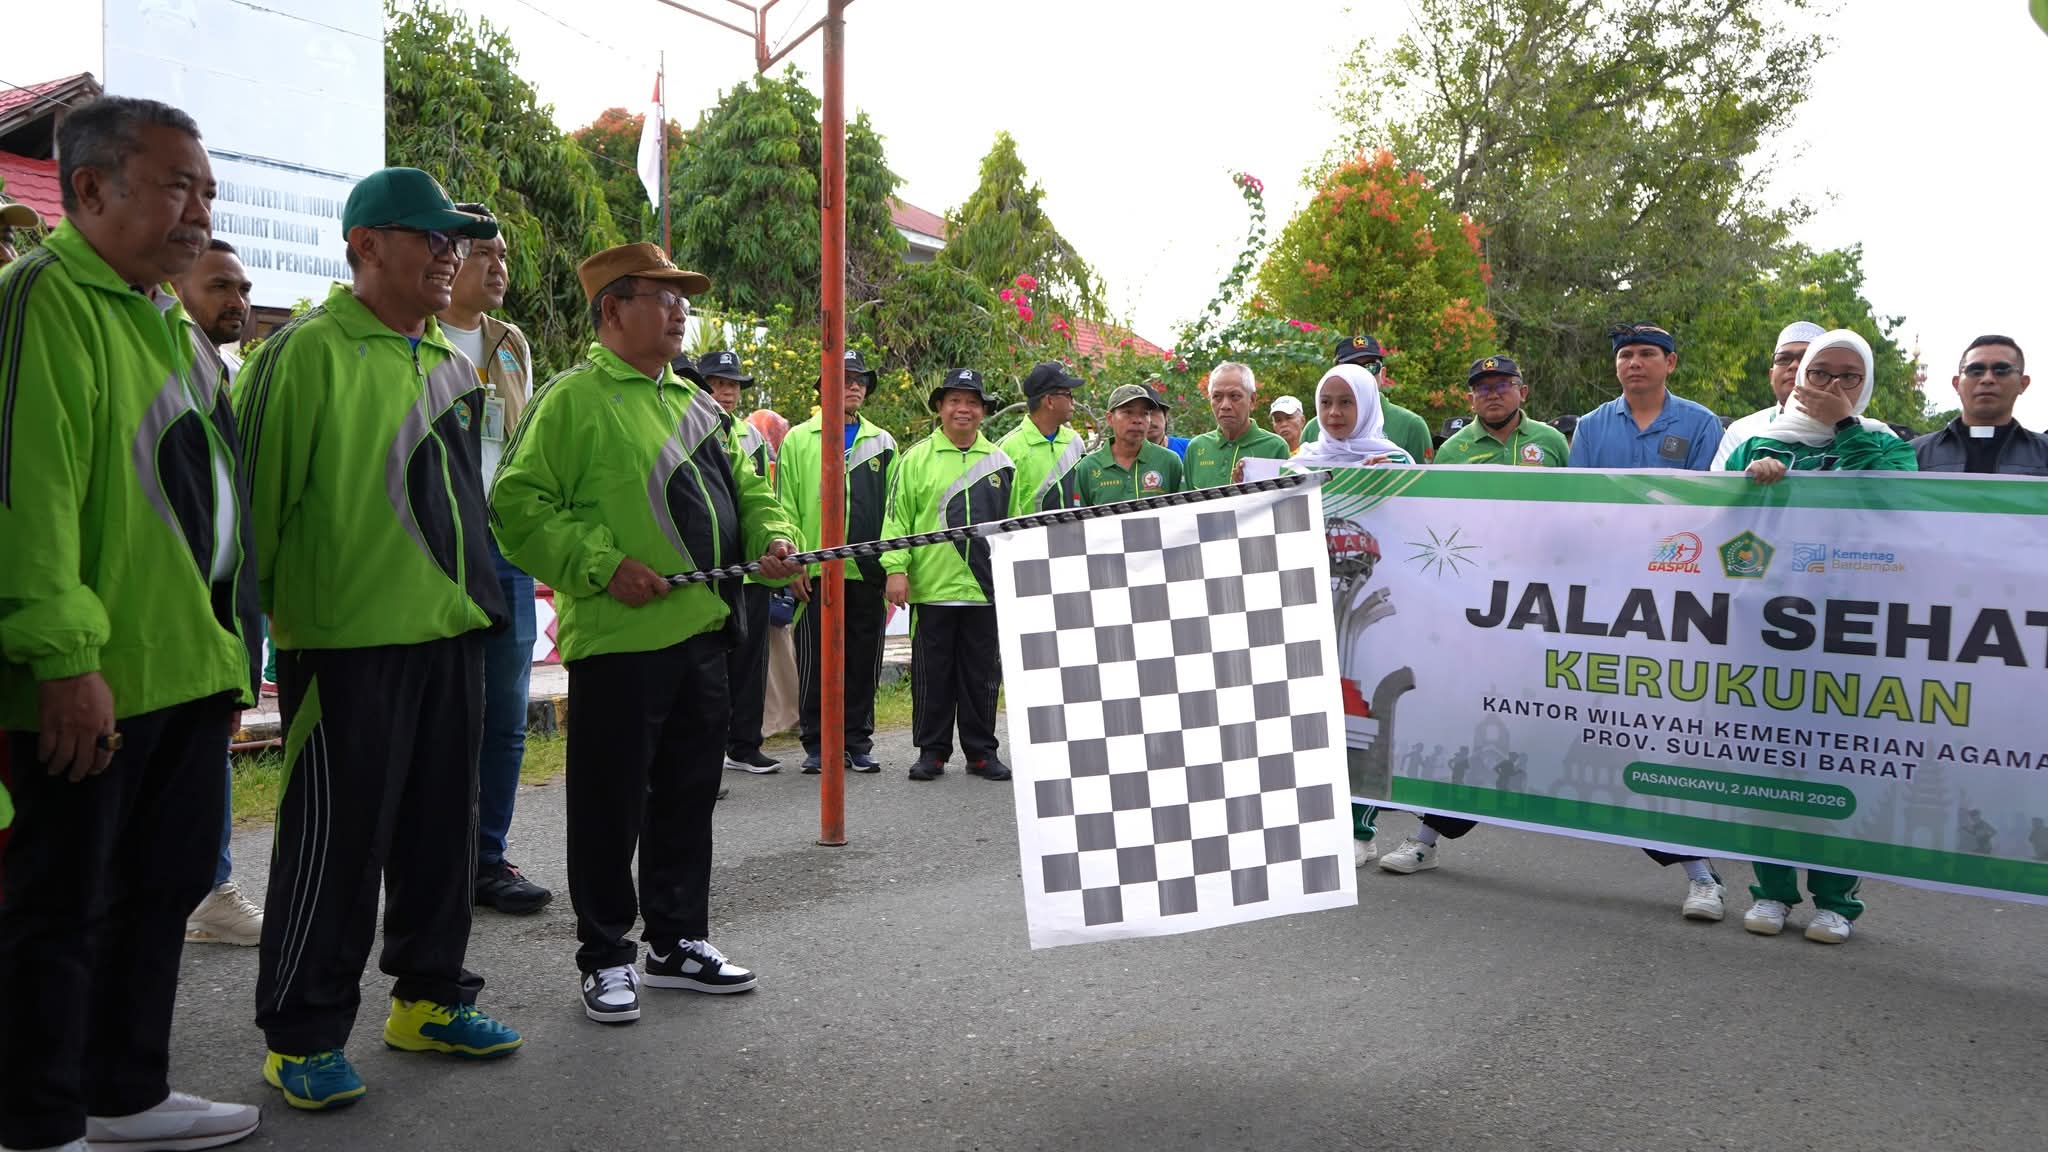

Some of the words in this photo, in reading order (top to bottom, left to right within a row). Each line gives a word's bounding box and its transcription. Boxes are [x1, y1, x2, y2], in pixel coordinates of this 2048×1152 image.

[218, 179, 281, 210] ABUPATEN
[211, 209, 270, 239] RETARIAT
[276, 250, 353, 281] PENGADAA
[1648, 562, 1701, 574] GASPUL
[1832, 548, 1895, 564] Kemenag
[1465, 580, 1730, 645] JALAN
[1545, 648, 1972, 728] KERUKUNAN
[1483, 697, 1578, 721] KANTOR
[1588, 708, 1703, 735] WILAYAH
[1715, 721, 1925, 758] KEMENTERIAN
[1937, 743, 2048, 770] AGAMA
[1583, 728, 1656, 752] PROV.
[1666, 738, 1806, 768] SULAWESI
[1819, 754, 1918, 780] BARAT
[1632, 771, 1728, 795] PASANGKAYU,
[1731, 783, 1740, 794] 2
[1743, 785, 1804, 802] JANUARI
[1807, 792, 1846, 808] 2026
